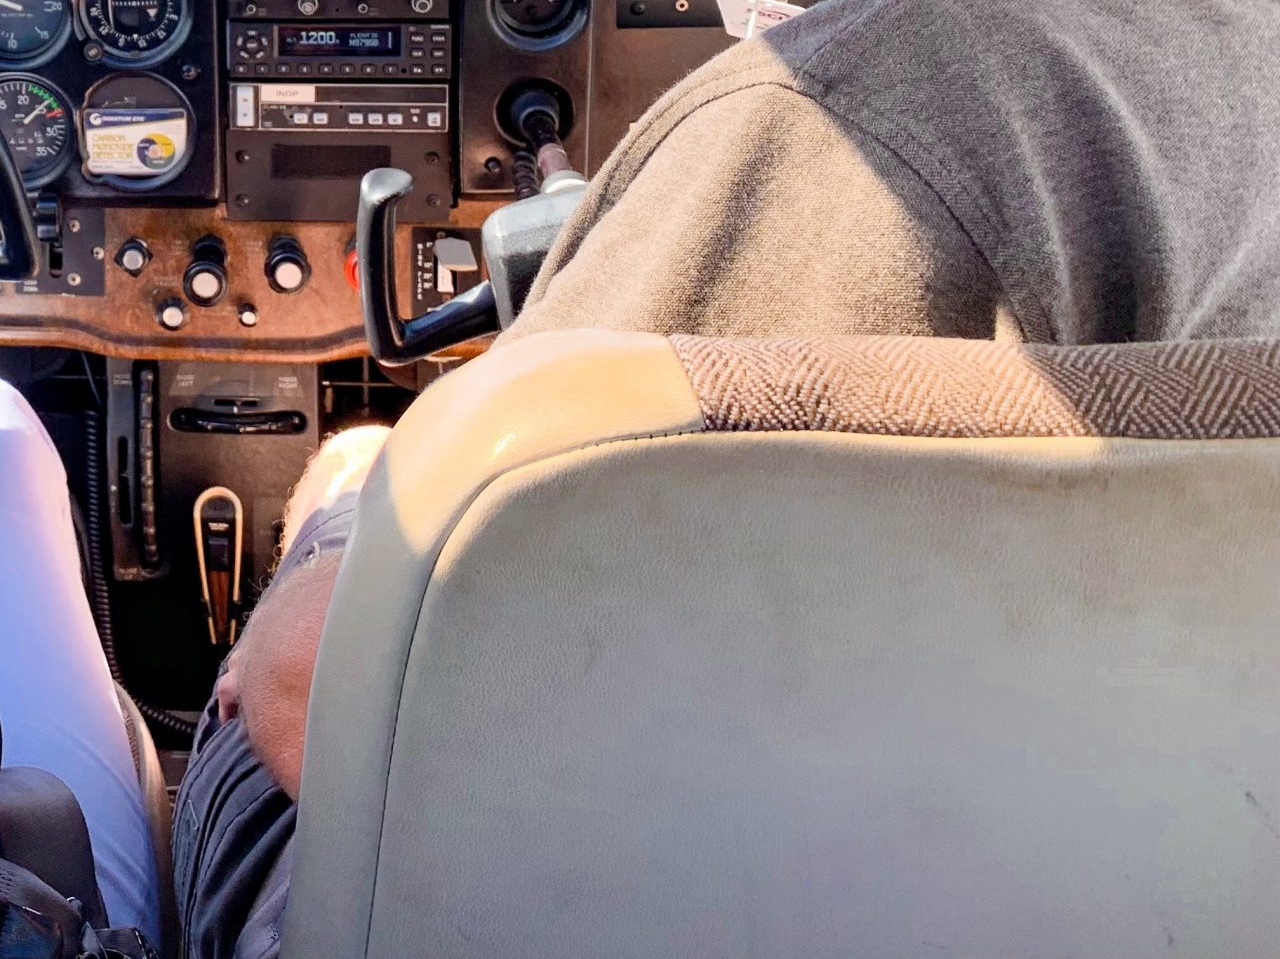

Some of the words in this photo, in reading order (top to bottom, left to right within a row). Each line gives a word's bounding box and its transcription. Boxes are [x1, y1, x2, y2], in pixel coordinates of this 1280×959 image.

[51, 2, 62, 11] 20
[40, 31, 49, 39] 15
[299, 31, 336, 45] 1200
[8, 40, 17, 49] 10
[17, 95, 29, 105] 20
[45, 127, 58, 136] 30
[91, 134, 127, 142] CARBON
[35, 146, 47, 156] 35
[91, 143, 135, 151] MONOXIDE
[92, 151, 134, 160] DETECTOR
